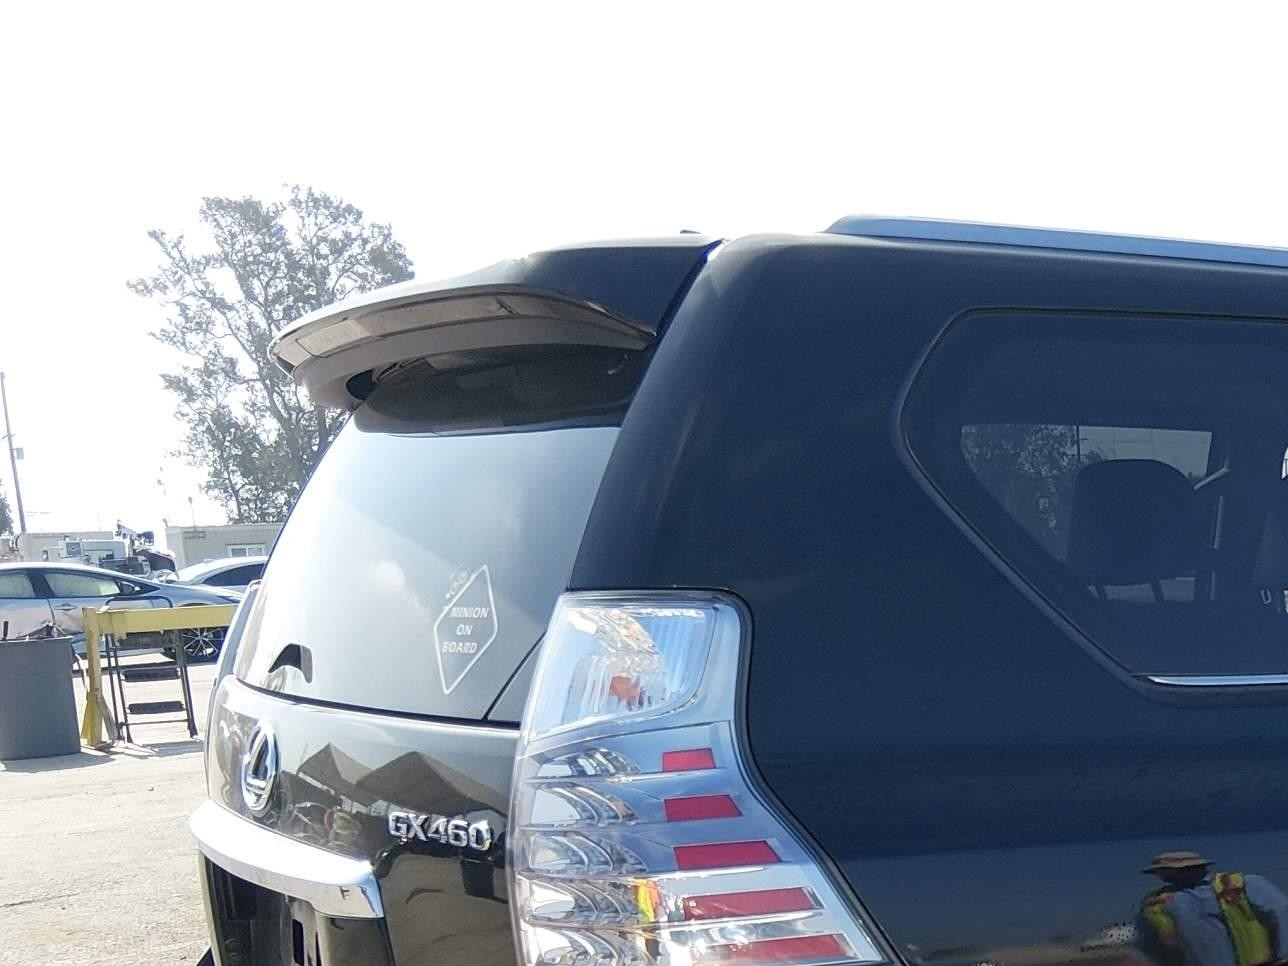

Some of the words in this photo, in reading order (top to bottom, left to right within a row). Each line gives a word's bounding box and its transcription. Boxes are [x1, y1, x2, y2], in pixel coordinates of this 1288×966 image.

[450, 606, 490, 619] MINION
[456, 623, 473, 636] ON
[442, 641, 478, 654] BOARD
[388, 811, 492, 851] GX460
